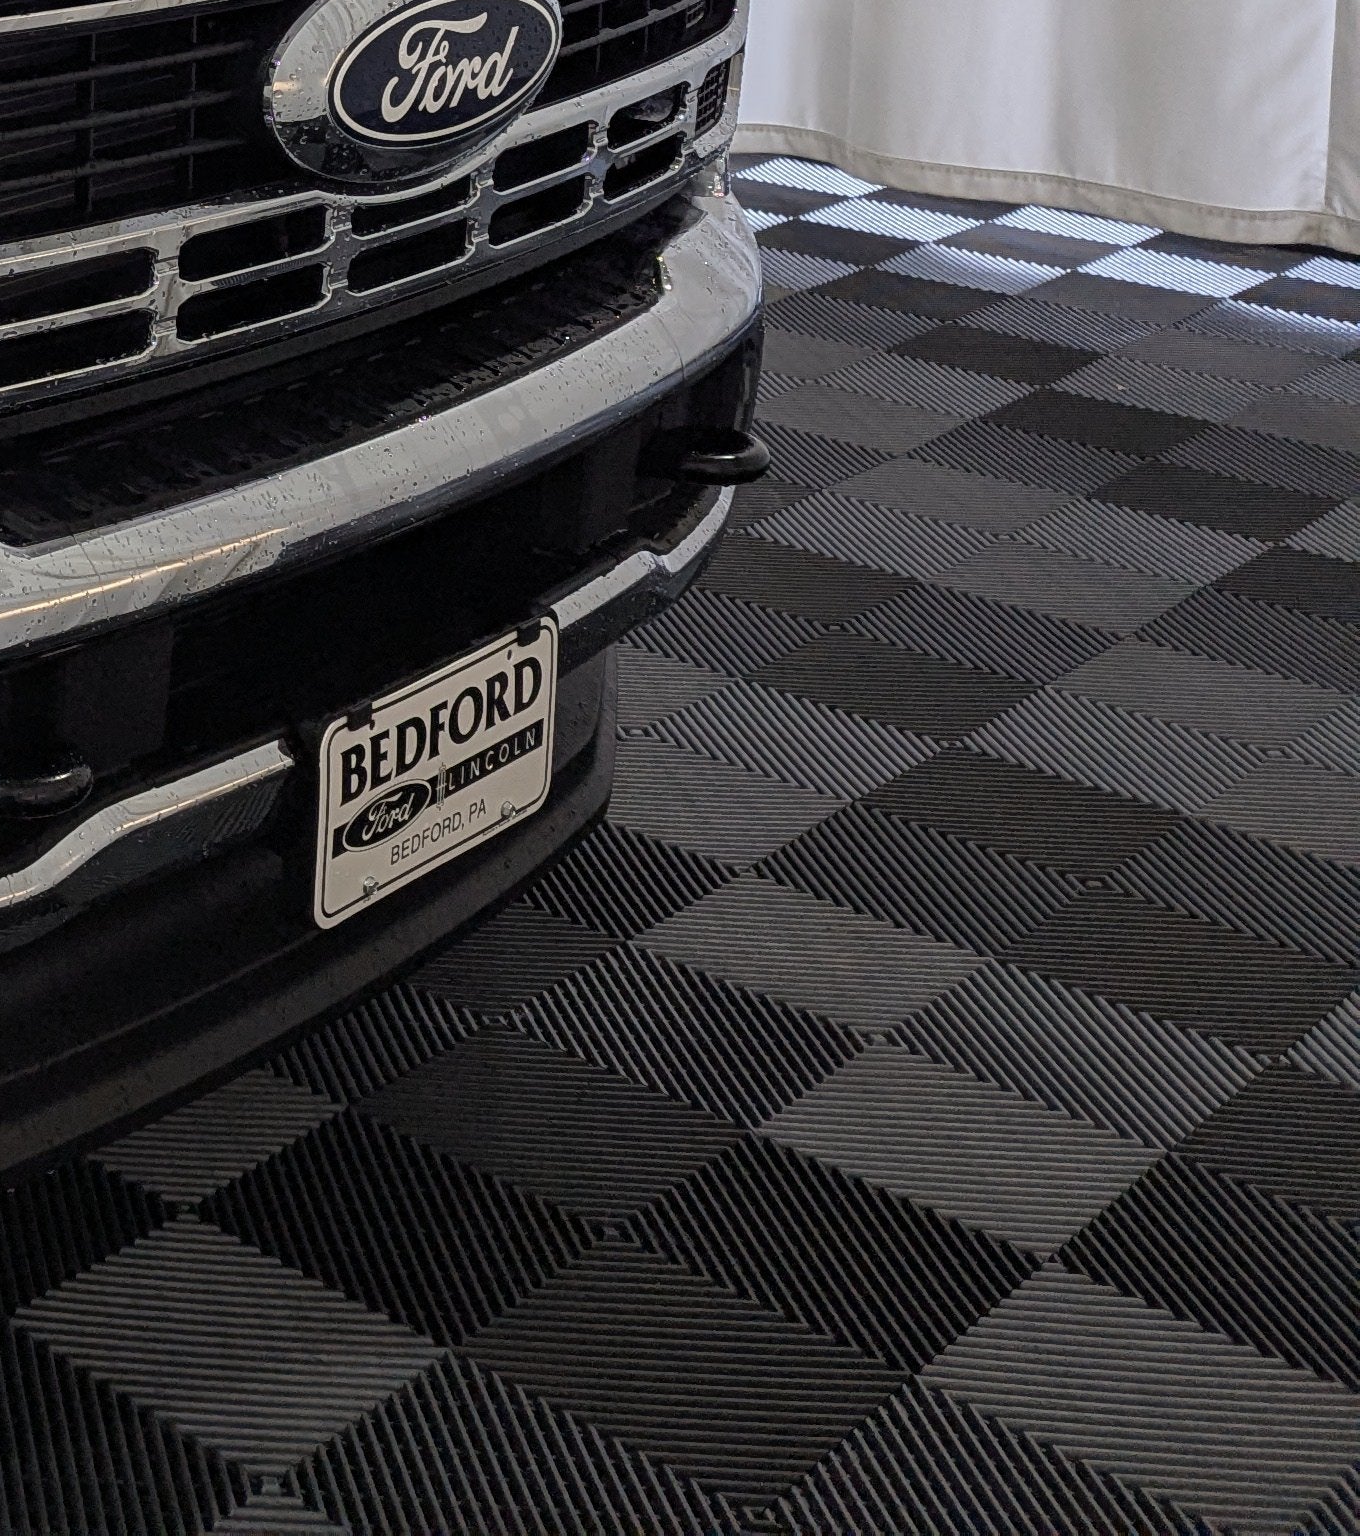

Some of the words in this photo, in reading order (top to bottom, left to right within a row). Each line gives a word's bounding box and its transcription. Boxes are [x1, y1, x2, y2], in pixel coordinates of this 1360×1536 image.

[381, 11, 519, 123] Ford
[339, 655, 543, 807] BEDFORD
[447, 726, 537, 791] LINCOLN
[361, 791, 415, 841] Ford
[390, 810, 465, 865] BEDFORD,
[467, 798, 487, 823] PA
